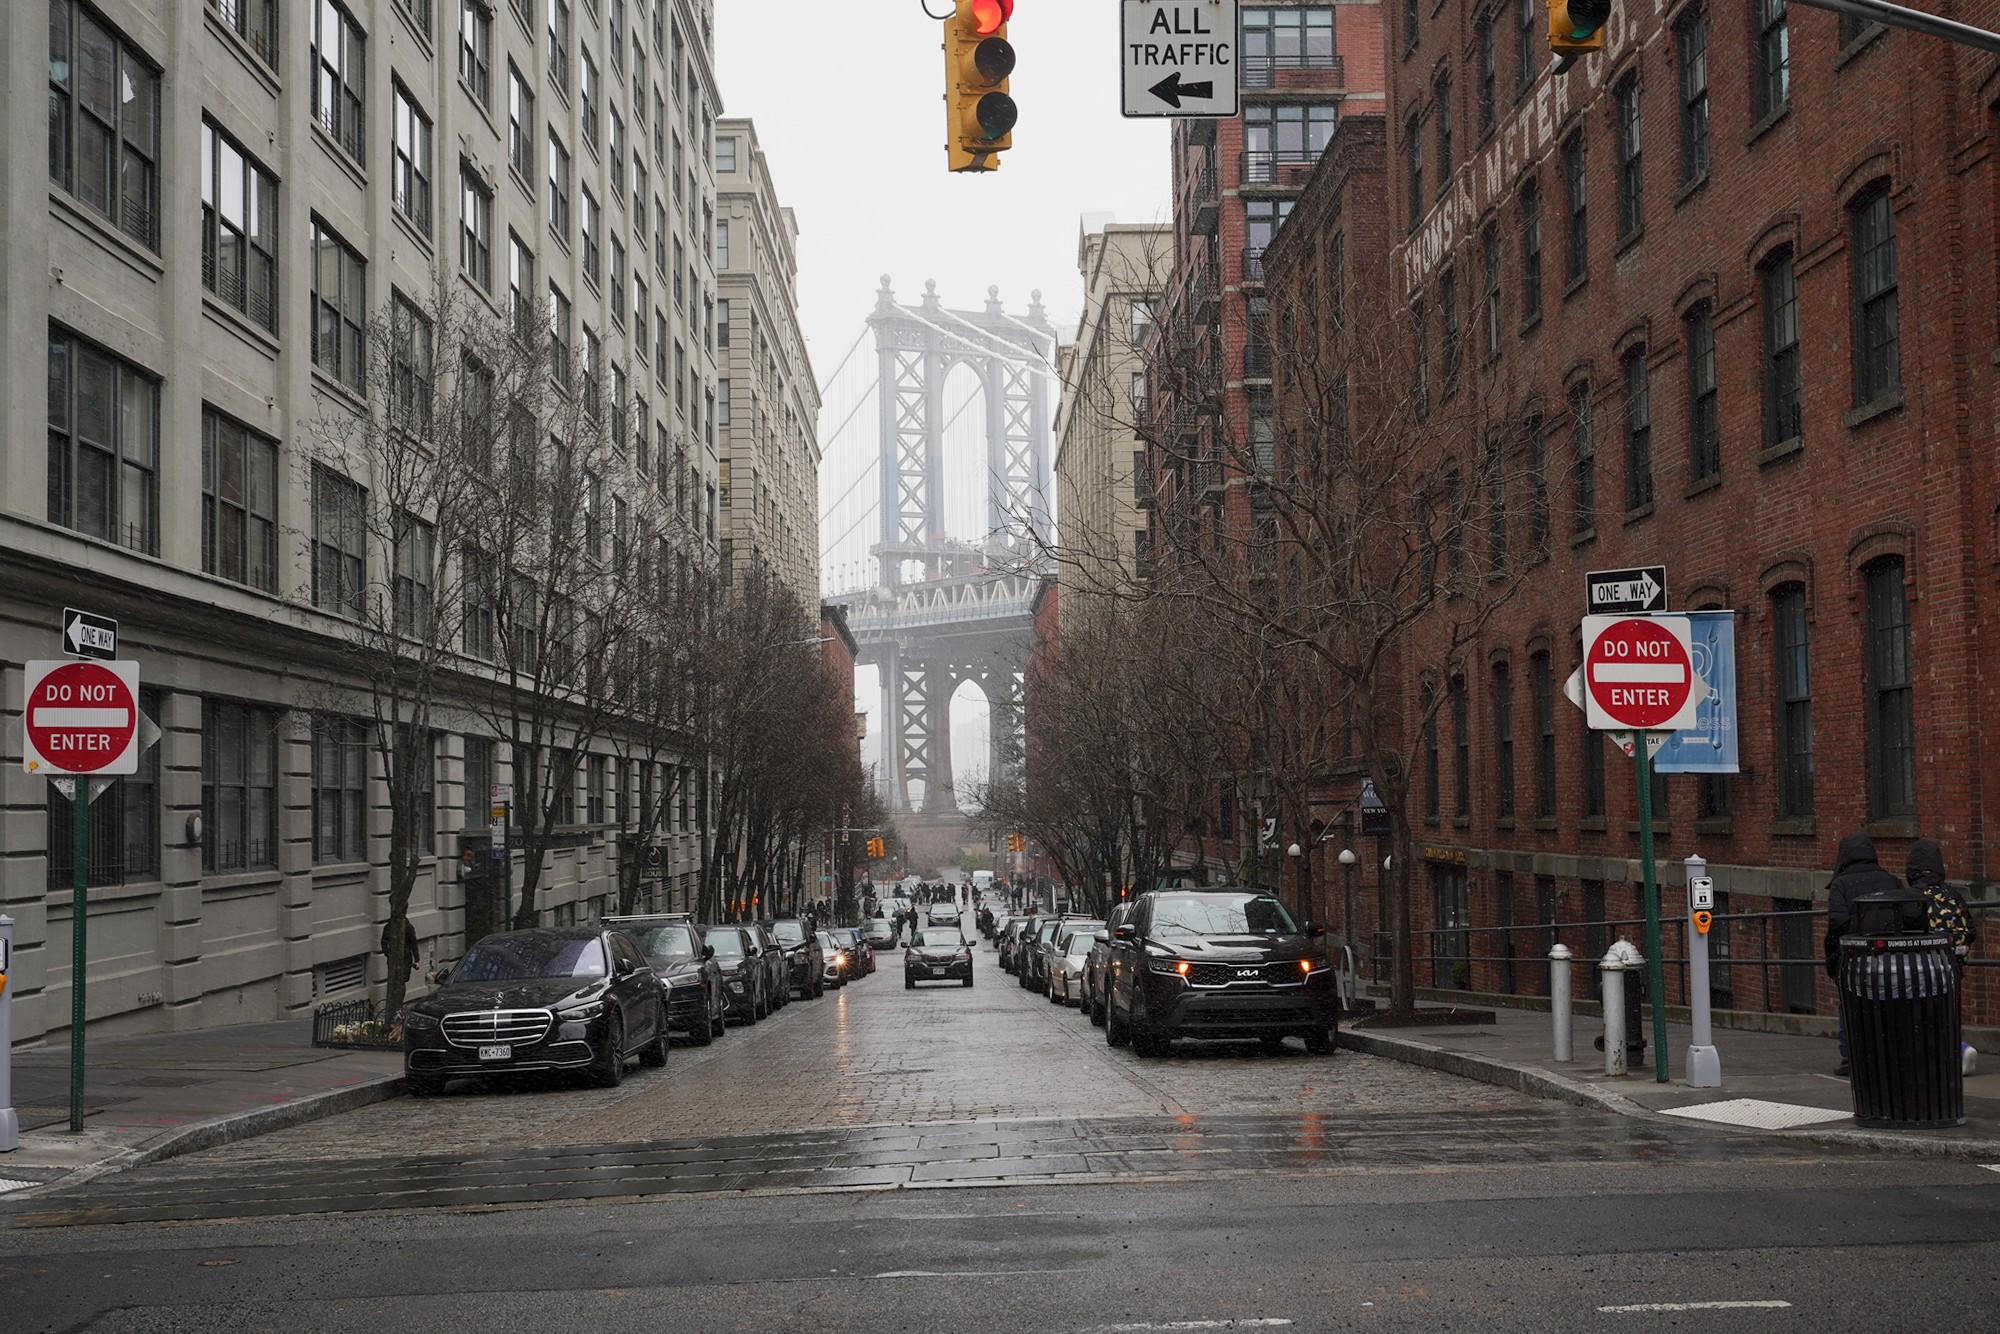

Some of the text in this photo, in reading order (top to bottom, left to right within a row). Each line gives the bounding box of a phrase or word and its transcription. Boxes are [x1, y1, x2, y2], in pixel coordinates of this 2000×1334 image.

[1149, 7, 1211, 35] ALL
[1130, 43, 1230, 66] TRAFFIC
[1485, 62, 1568, 202] METER
[1598, 581, 1653, 602] ONE WAY
[81, 626, 113, 649] ONE WAY
[1604, 640, 1671, 658] DO NOT
[46, 685, 117, 702] DO NOT
[1612, 689, 1670, 706] ENTER
[50, 734, 111, 751] ENTER
